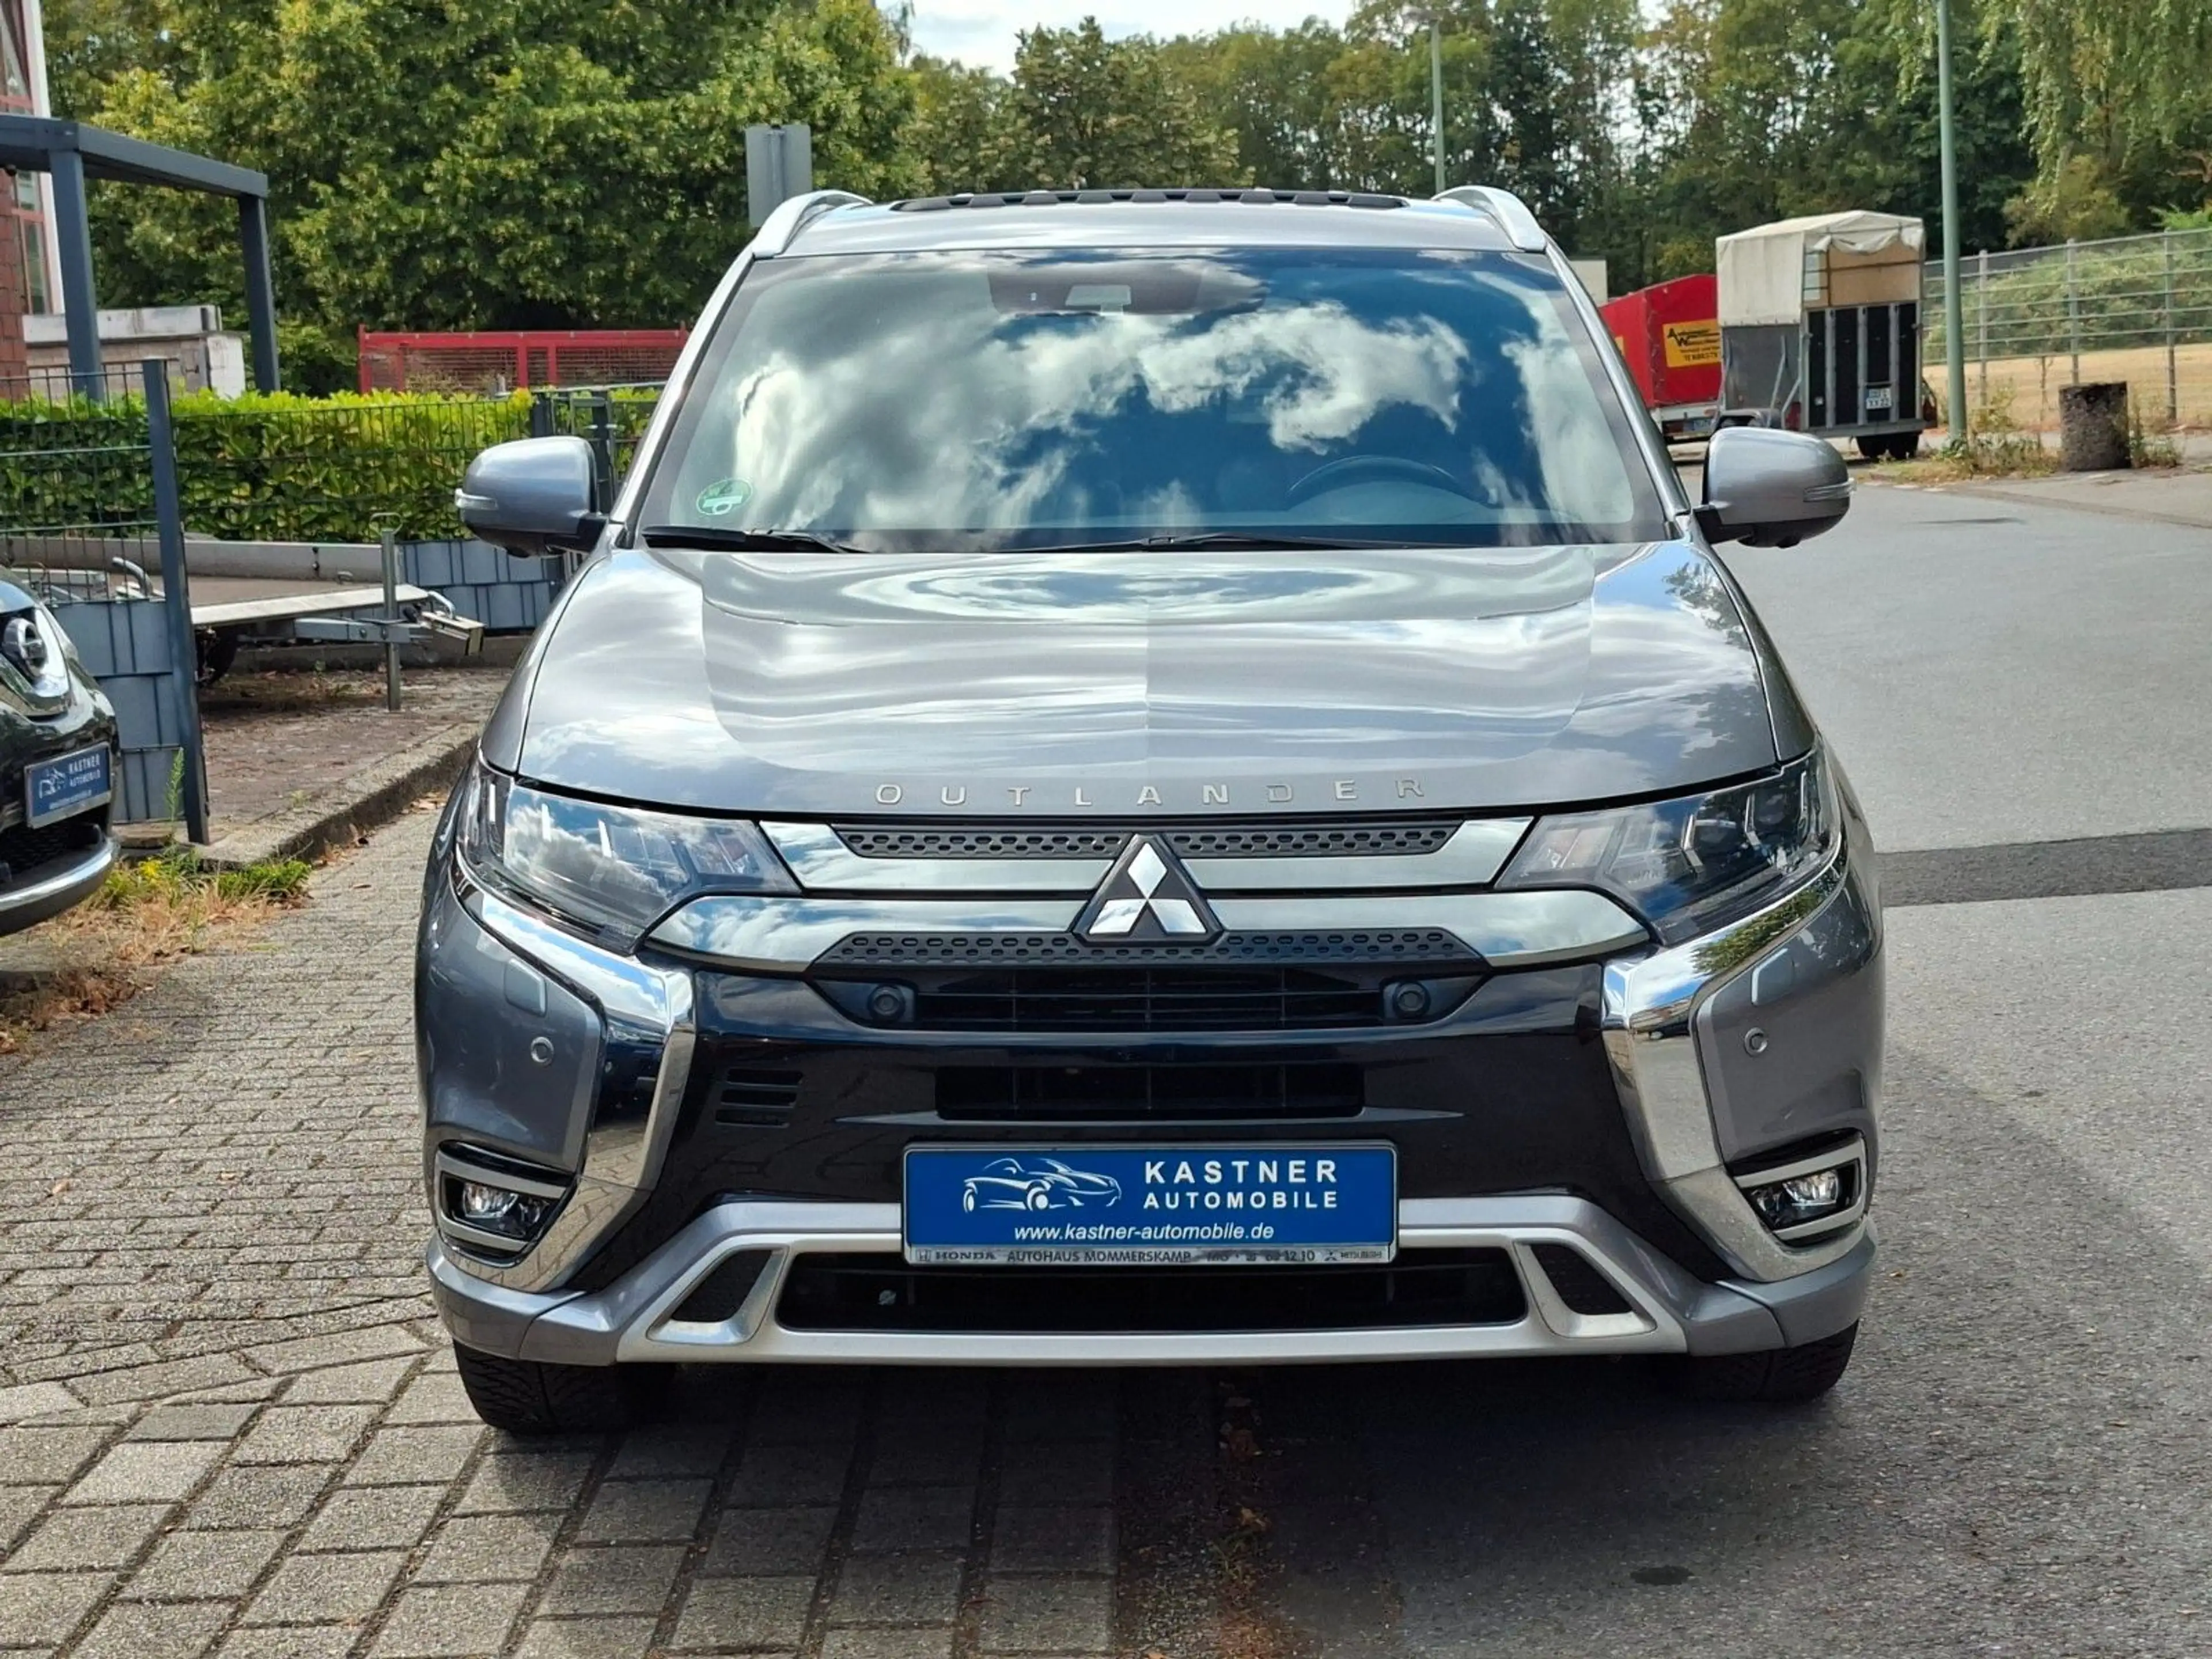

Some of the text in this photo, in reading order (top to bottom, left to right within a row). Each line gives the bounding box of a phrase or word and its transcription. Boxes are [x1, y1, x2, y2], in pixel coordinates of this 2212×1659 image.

[875, 779, 1425, 806] OUTLANDER
[1145, 1160, 1337, 1184] KASTNER
[1143, 1191, 1338, 1209] AUTOMOBILE
[1014, 1222, 1275, 1241] www.kastner-automobile.de
[935, 1251, 997, 1260] HONDA
[1007, 1251, 1081, 1262] AUTOHAUS
